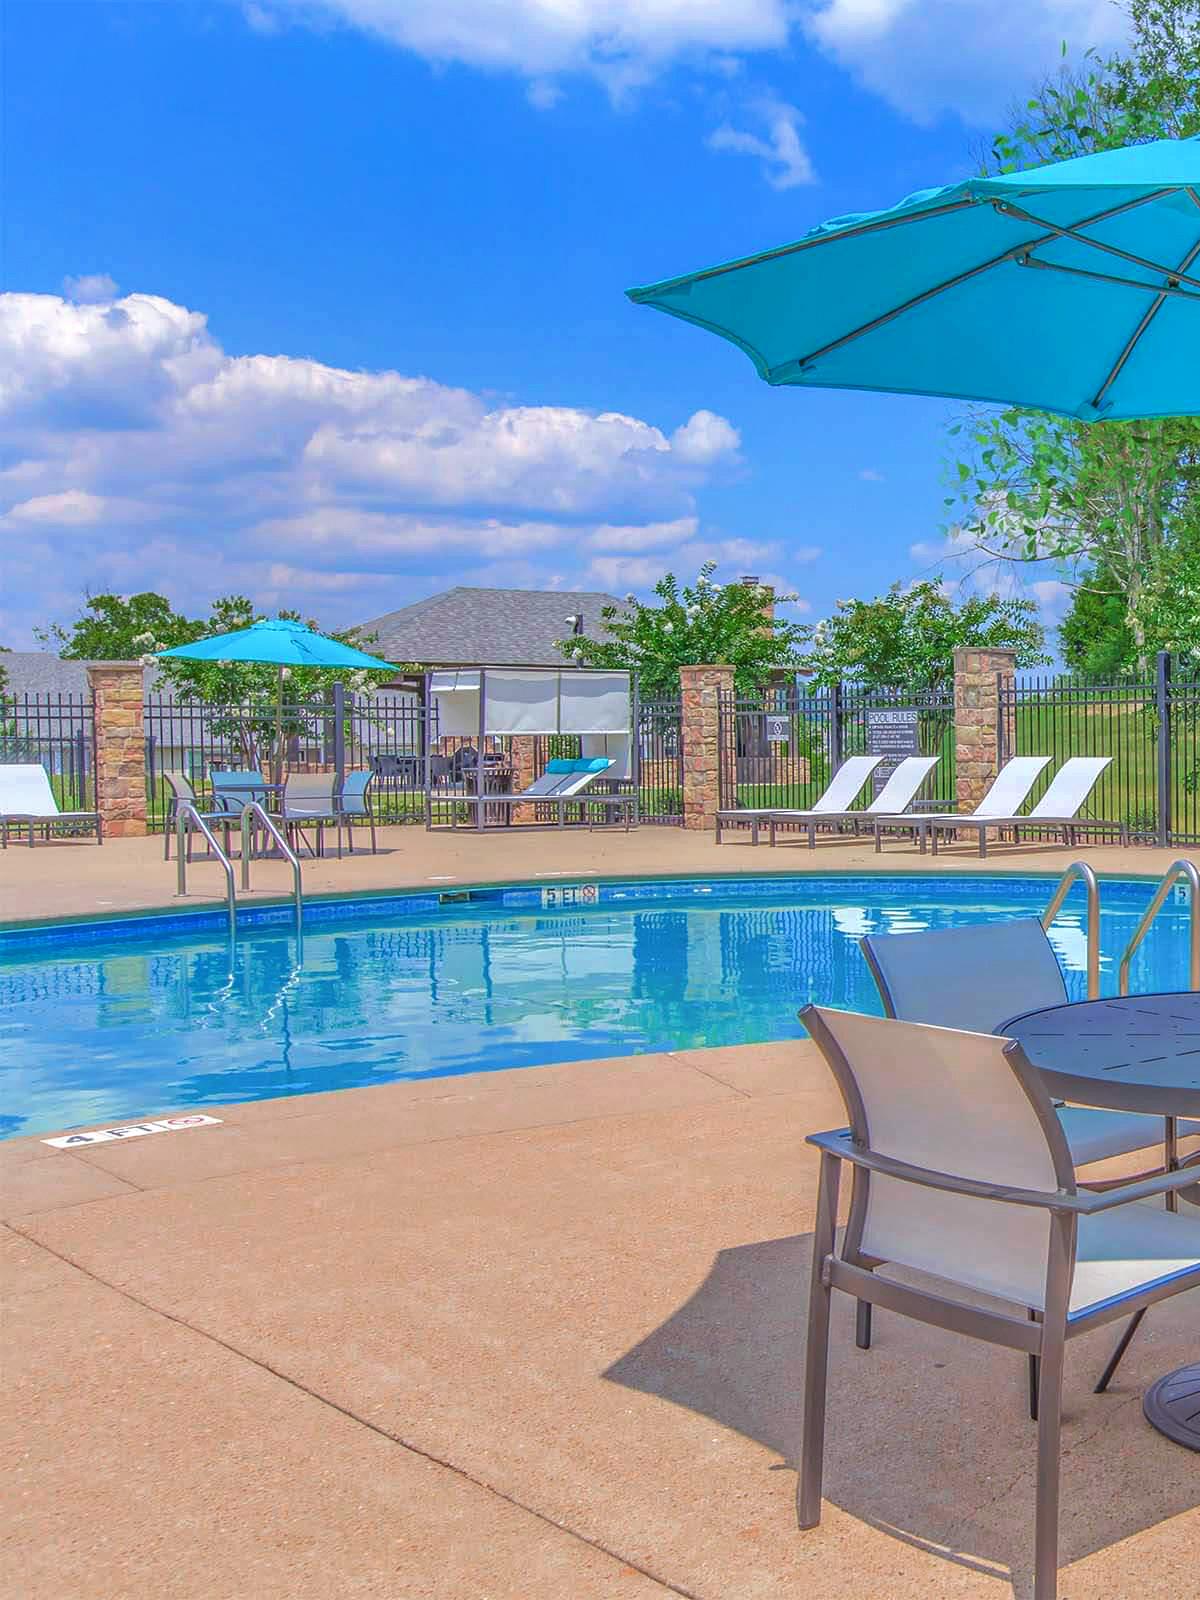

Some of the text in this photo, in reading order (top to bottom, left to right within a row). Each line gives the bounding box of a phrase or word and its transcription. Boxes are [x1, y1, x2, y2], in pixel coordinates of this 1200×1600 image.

[869, 712, 916, 722] POOL RULES
[106, 1125, 152, 1136] FT
